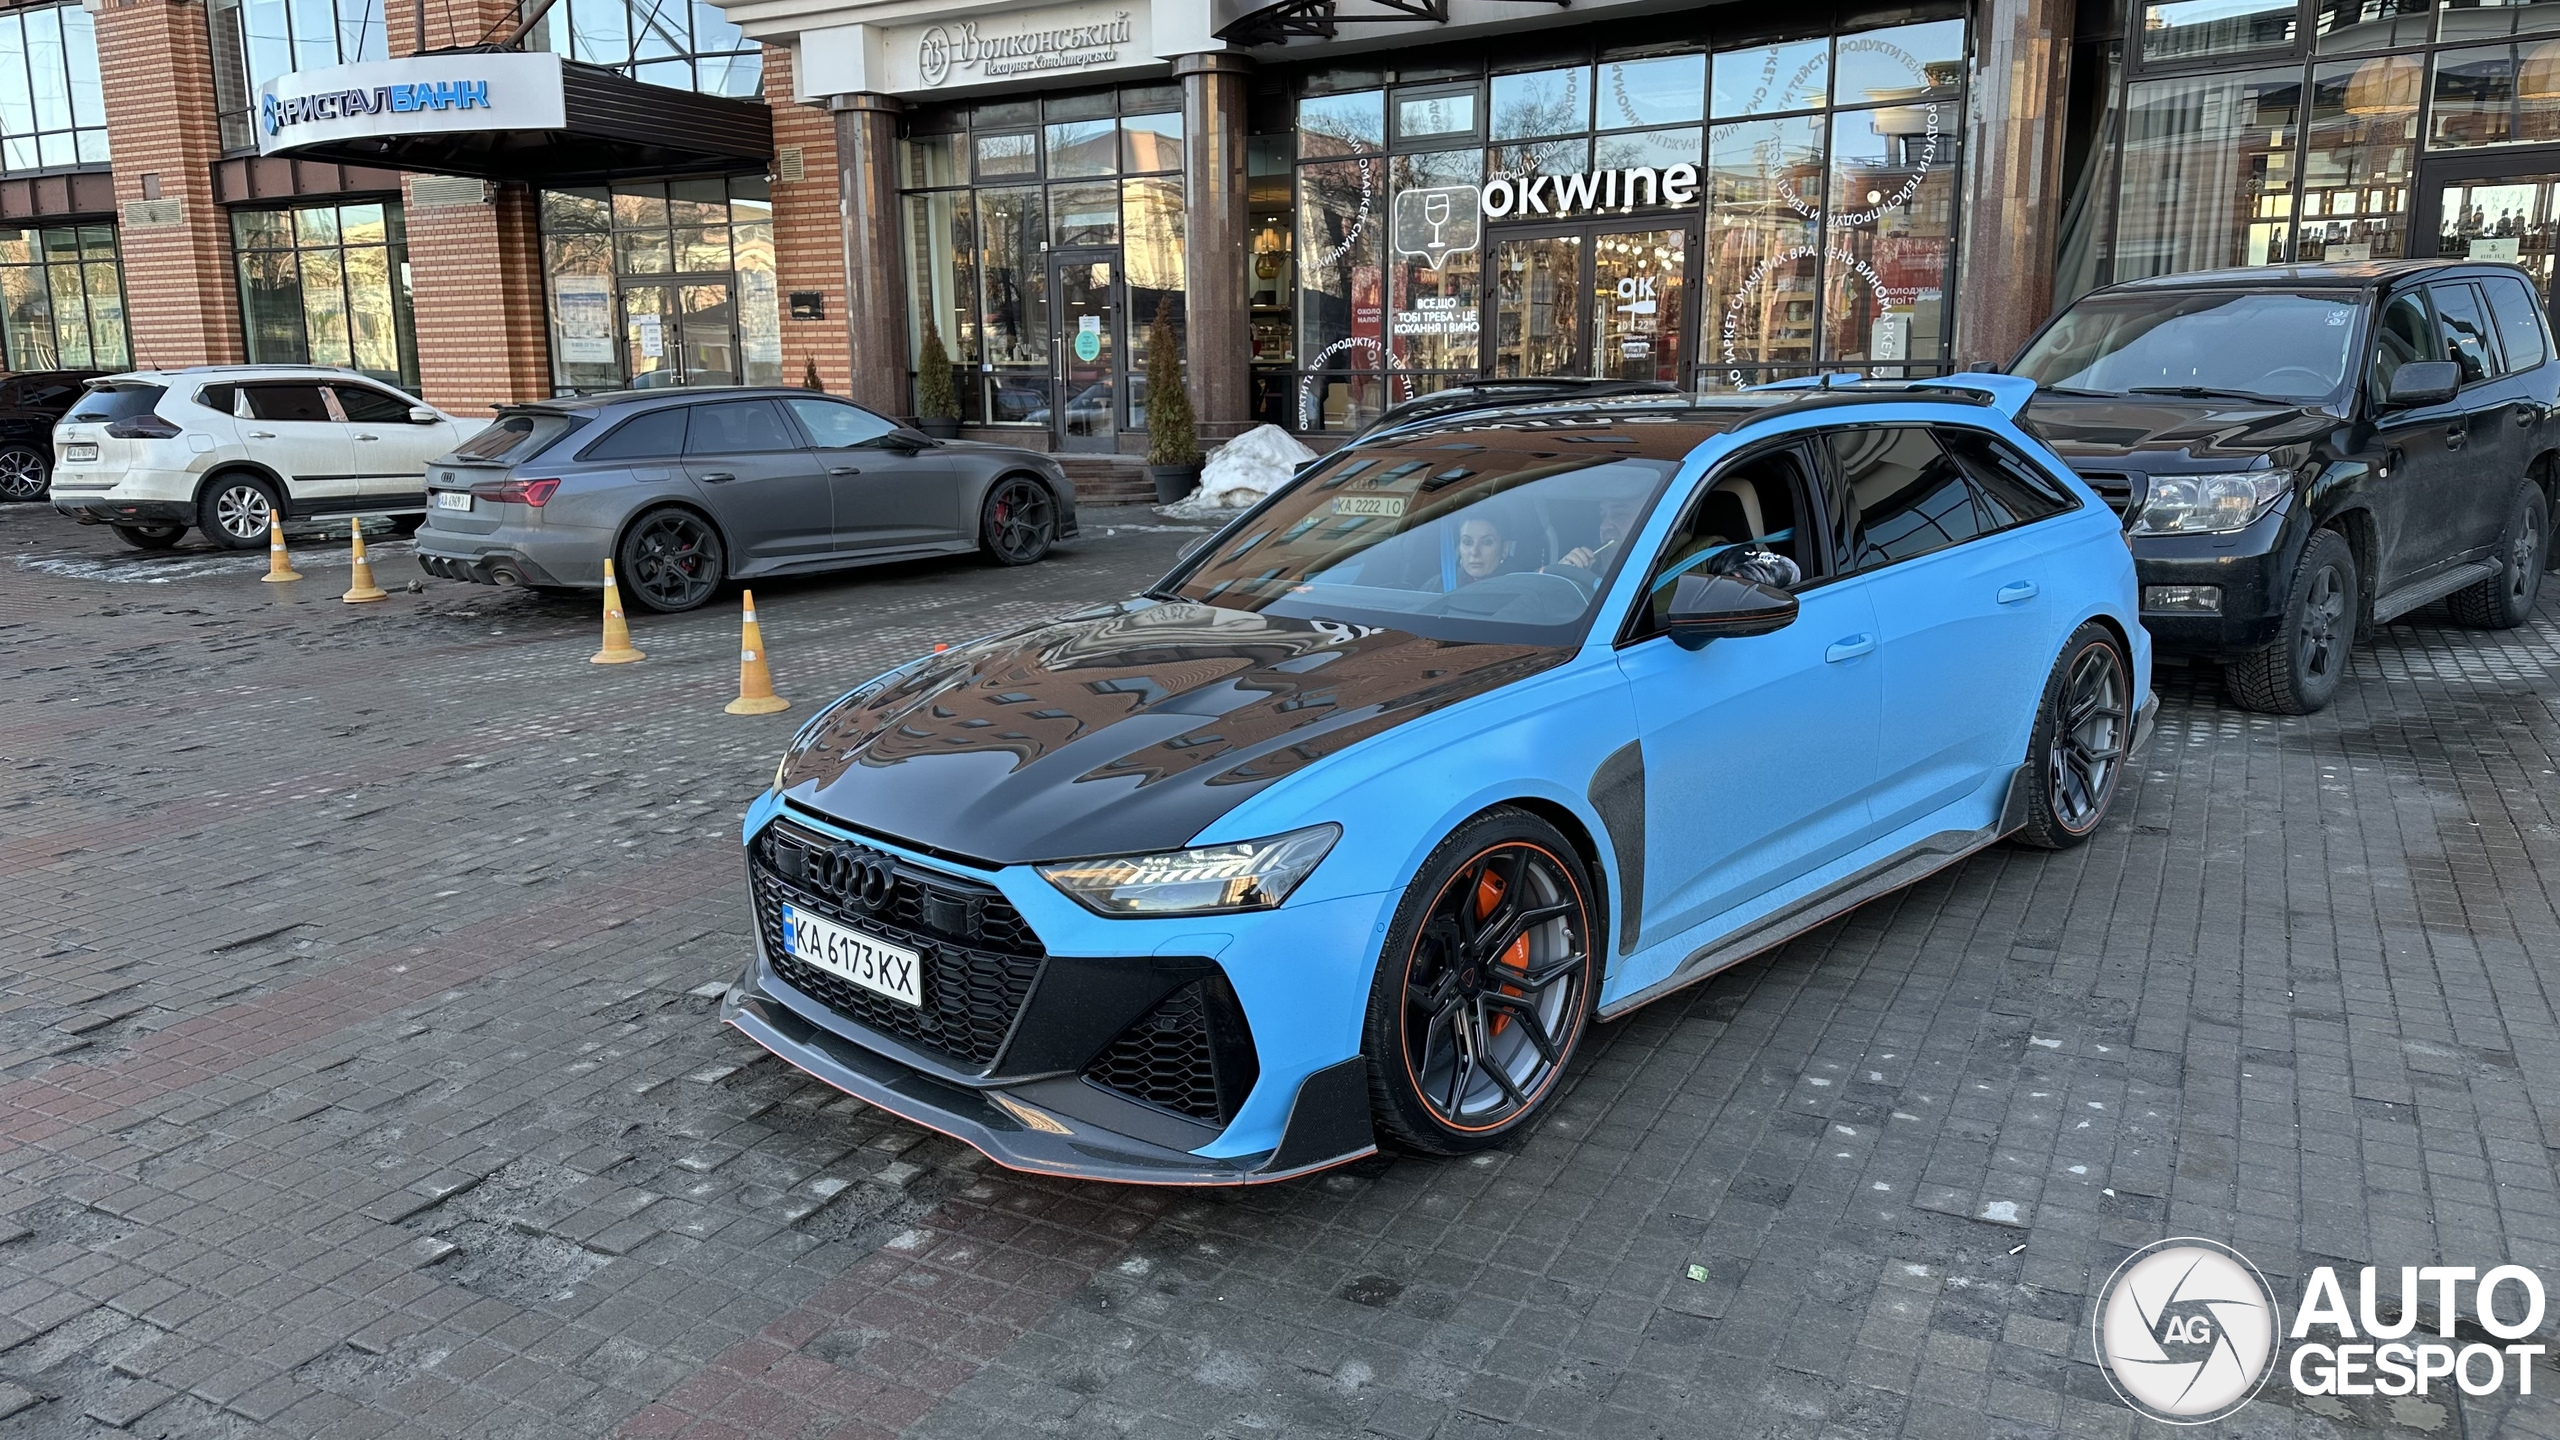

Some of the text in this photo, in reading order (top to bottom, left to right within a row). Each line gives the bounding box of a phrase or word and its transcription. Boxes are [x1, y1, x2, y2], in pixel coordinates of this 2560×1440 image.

[955, 11, 1131, 69] Волконський
[1032, 49, 1116, 69] Кондитерська
[274, 80, 492, 127] КРИСТАЛБАНК
[1917, 102, 1939, 172] РОДУКТИ
[1777, 179, 1809, 216] ТЕЙСТІ
[1883, 174, 1924, 214] ТЕЙСТІ
[1316, 223, 1362, 268] СМАЧНИХ
[1617, 276, 1656, 298] OK
[1731, 251, 1787, 310] СМАЧНИХ
[1394, 323, 1441, 334] КОХАННЯ
[1449, 322, 1480, 333] ВИНО
[1398, 312, 1421, 323] ТОБІ
[1423, 312, 1454, 322] ТРЕБА
[1462, 310, 1477, 321] ЦЕ
[1855, 259, 1895, 360] ВИНОМАРКЕТ
[1326, 336, 1376, 357] ПРОДУКТИ
[1337, 499, 1351, 512] KA
[1355, 499, 1381, 513] 2222
[795, 916, 914, 997] KA 6173 KX
